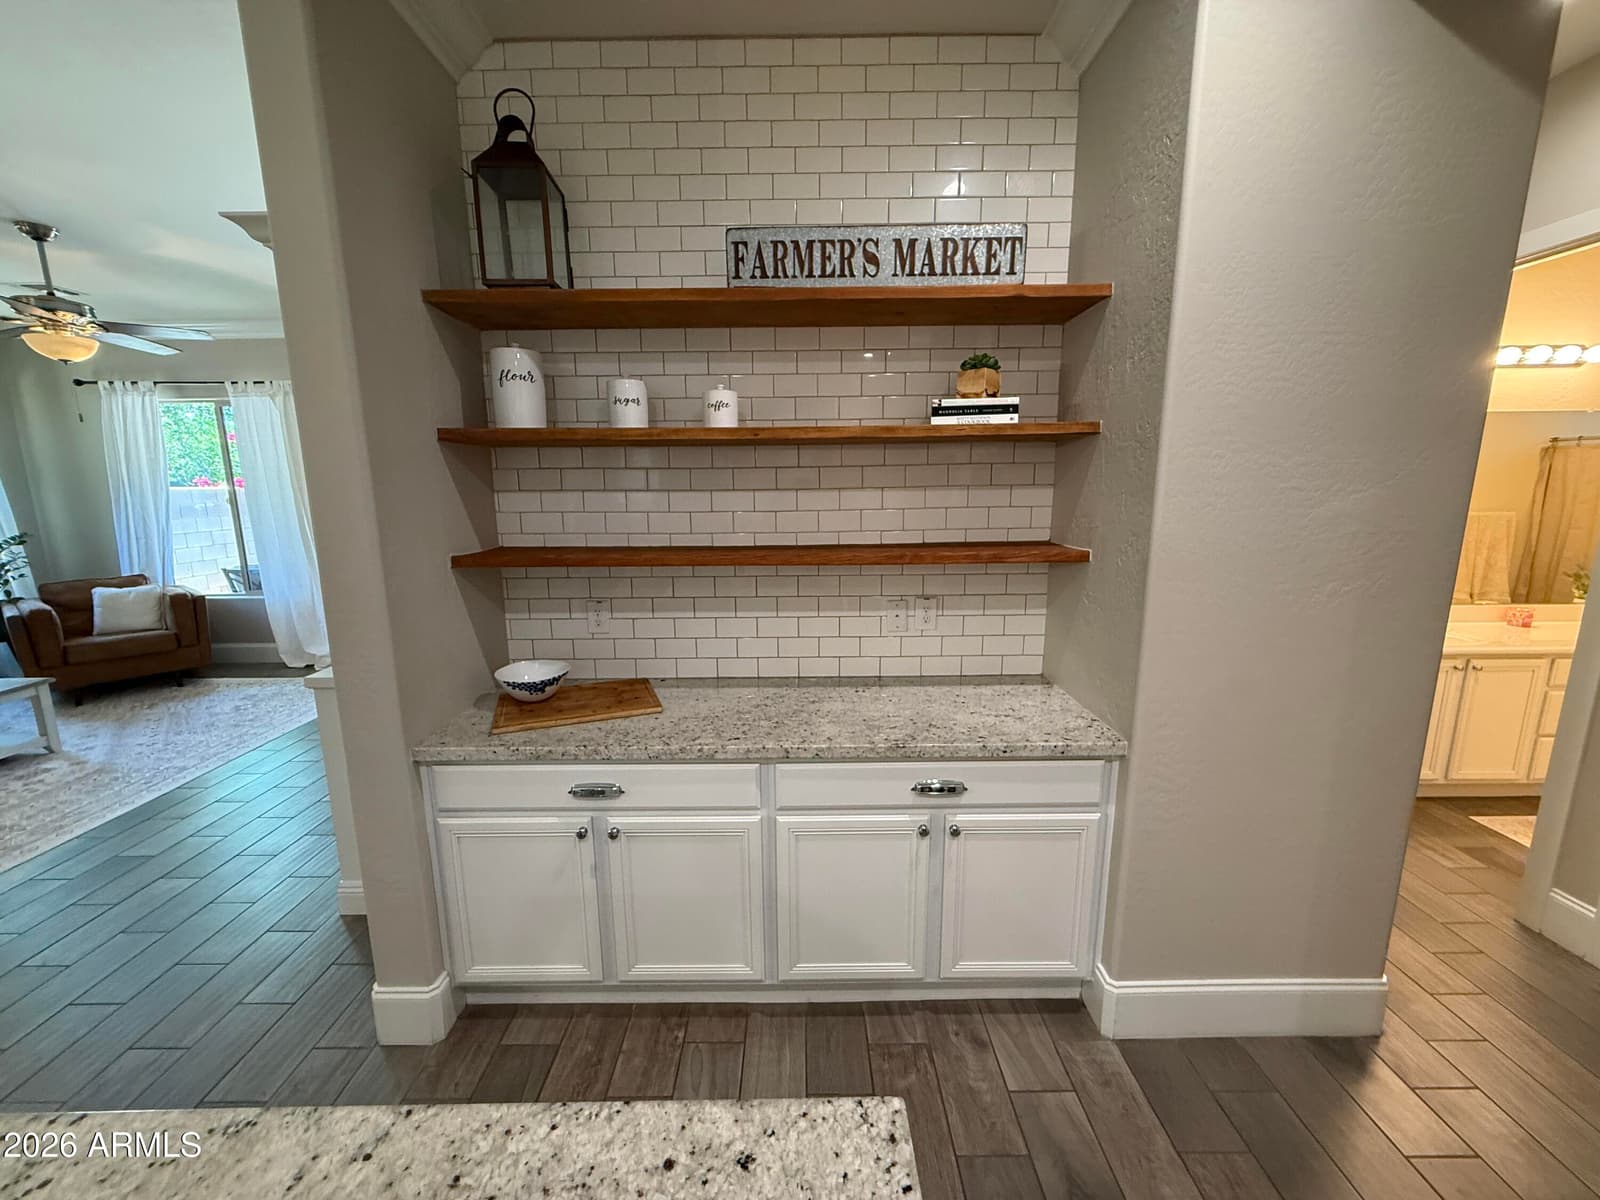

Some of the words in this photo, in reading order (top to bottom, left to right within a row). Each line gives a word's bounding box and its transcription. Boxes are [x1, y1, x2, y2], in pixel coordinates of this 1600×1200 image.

[731, 237, 880, 280] FARMER'S
[892, 236, 1023, 277] MARKET
[498, 368, 537, 387] flour
[613, 395, 641, 407] sugar
[706, 399, 731, 412] coffee
